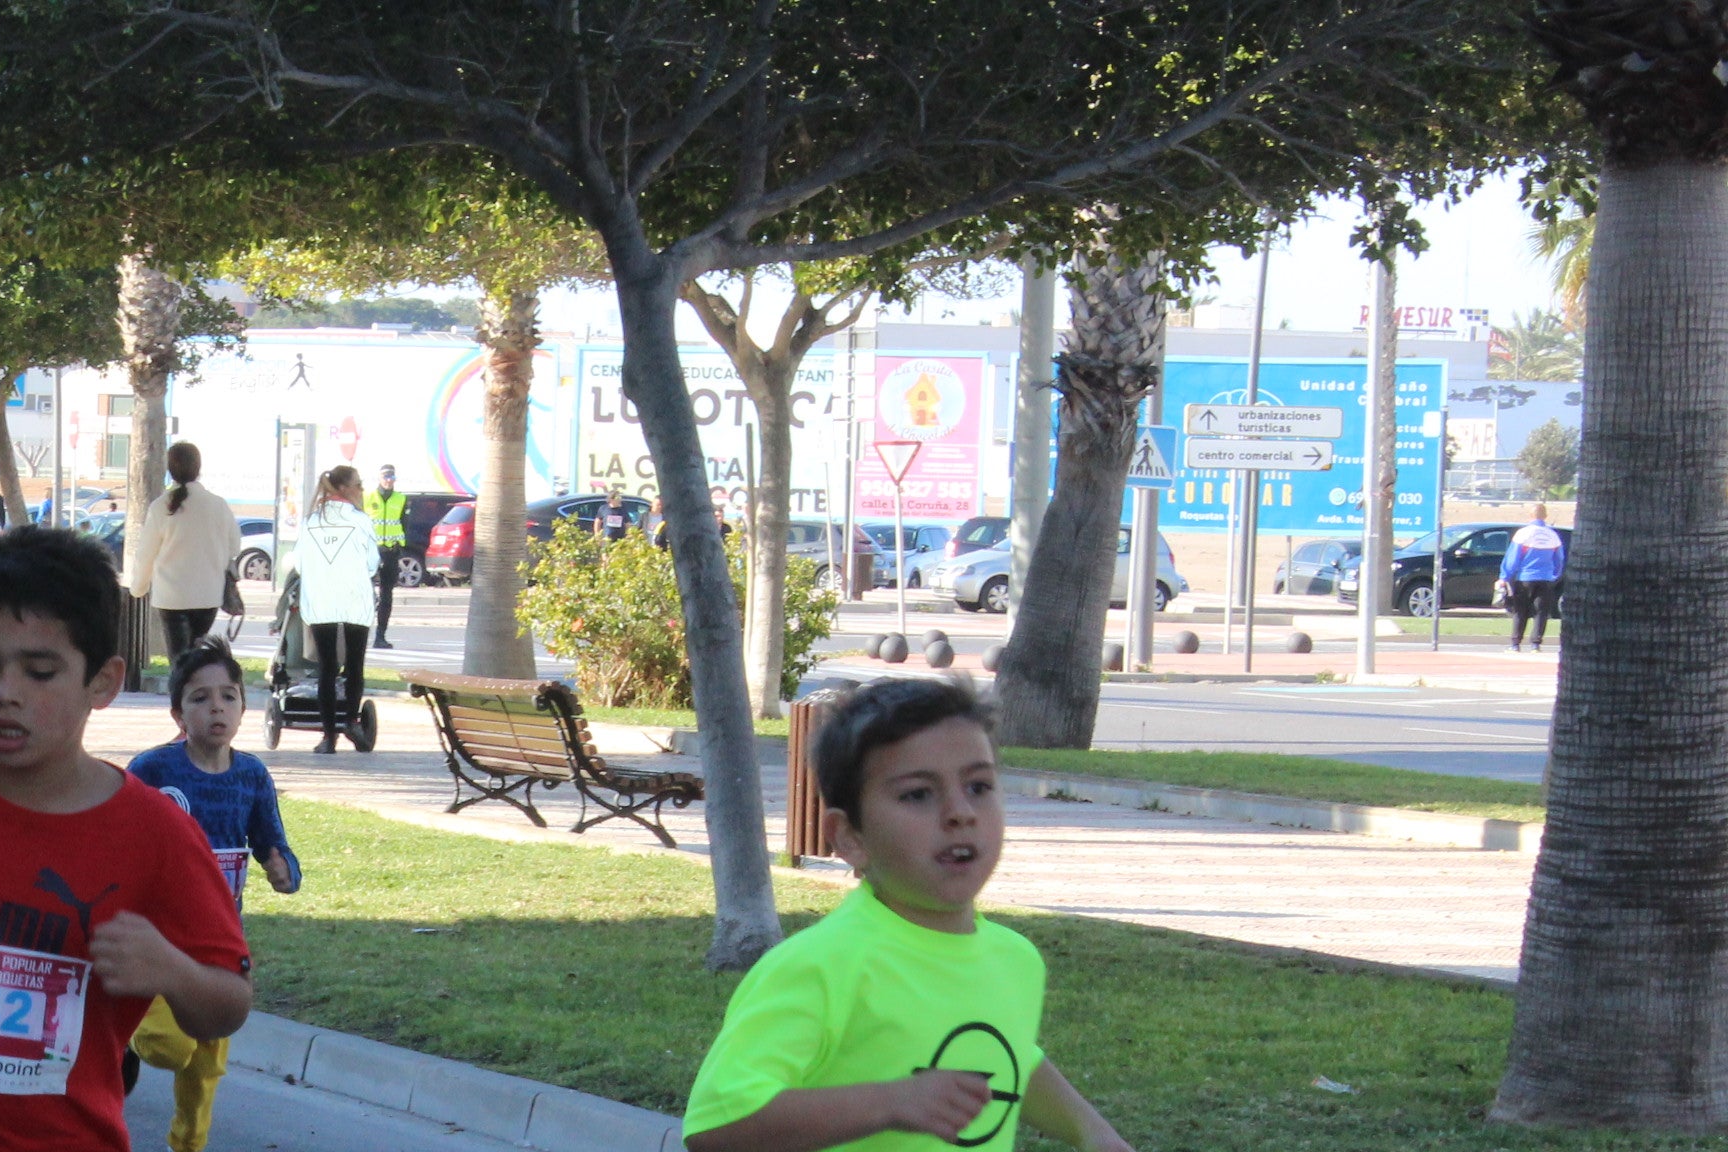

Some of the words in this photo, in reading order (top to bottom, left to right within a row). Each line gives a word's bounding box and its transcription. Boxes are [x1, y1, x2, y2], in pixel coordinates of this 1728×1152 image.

[1360, 305, 1453, 327] RMESUR
[590, 364, 623, 377] CEN
[914, 361, 954, 378] Casita
[230, 375, 282, 393] English
[1299, 380, 1355, 392] Unidad
[1398, 380, 1428, 392] año
[1357, 394, 1427, 407] Cbral
[1238, 410, 1322, 422] urbanizaciones
[1198, 451, 1235, 461] centro
[1238, 450, 1293, 461] comercial
[589, 453, 625, 478] LA
[860, 480, 895, 497] 950
[937, 482, 972, 499] 583
[1167, 482, 1293, 506] EUROAR
[861, 500, 887, 510] calle
[956, 502, 969, 511] 28
[1398, 493, 1422, 505] 030
[1180, 511, 1225, 523] Roquetas
[1317, 514, 1346, 524] Avda.
[323, 536, 338, 545] UP
[2, 955, 53, 975] POPULAR
